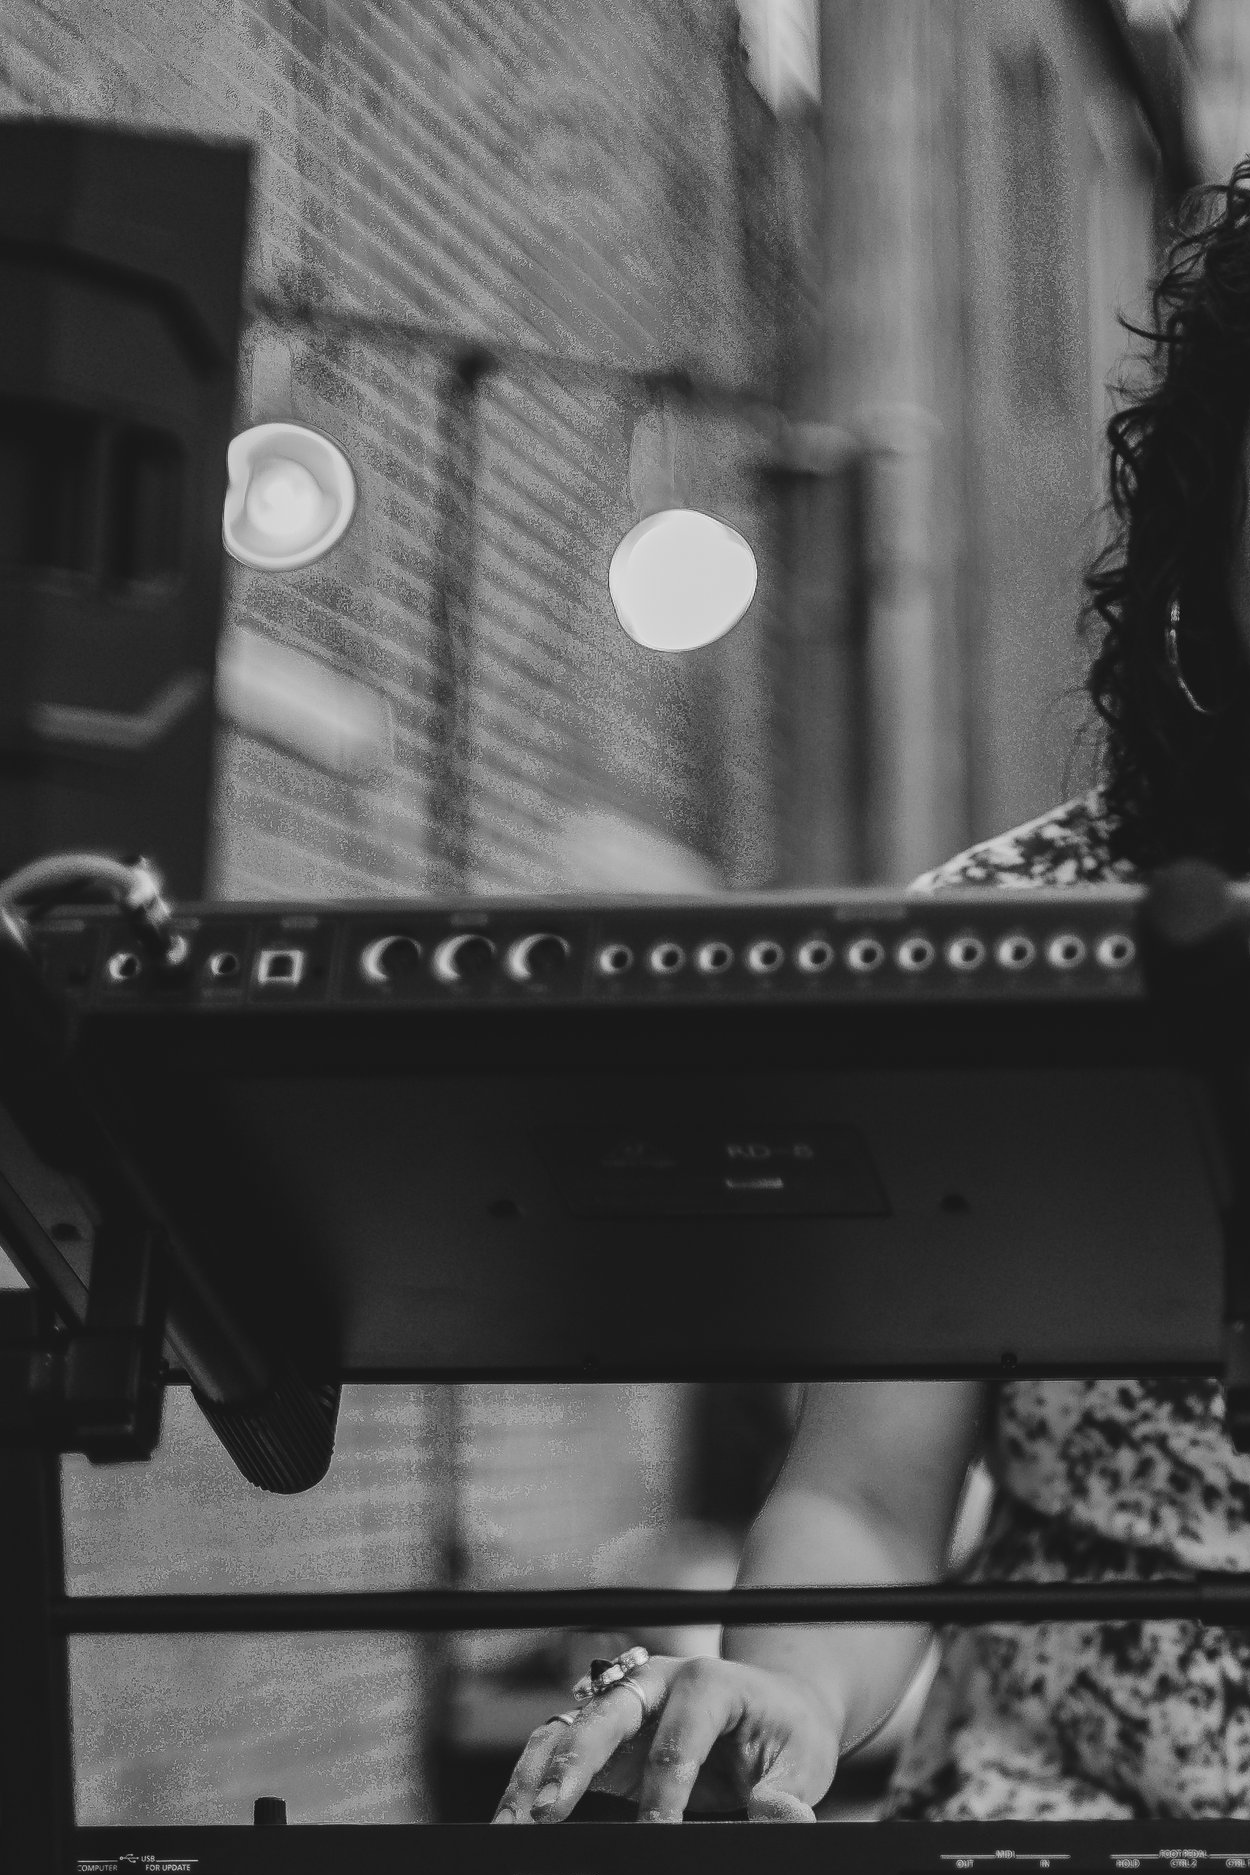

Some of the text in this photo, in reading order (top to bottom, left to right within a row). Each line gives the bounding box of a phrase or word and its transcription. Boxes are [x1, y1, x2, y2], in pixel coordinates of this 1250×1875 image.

[995, 1849, 1015, 1859] MIDI
[1159, 1849, 1207, 1858] FOOT PEDAL
[141, 1855, 156, 1863] USB
[955, 1859, 974, 1868] OUT
[1039, 1859, 1051, 1868] IN
[1116, 1859, 1140, 1868] HOLD
[145, 1864, 191, 1872] FOR UPDATE
